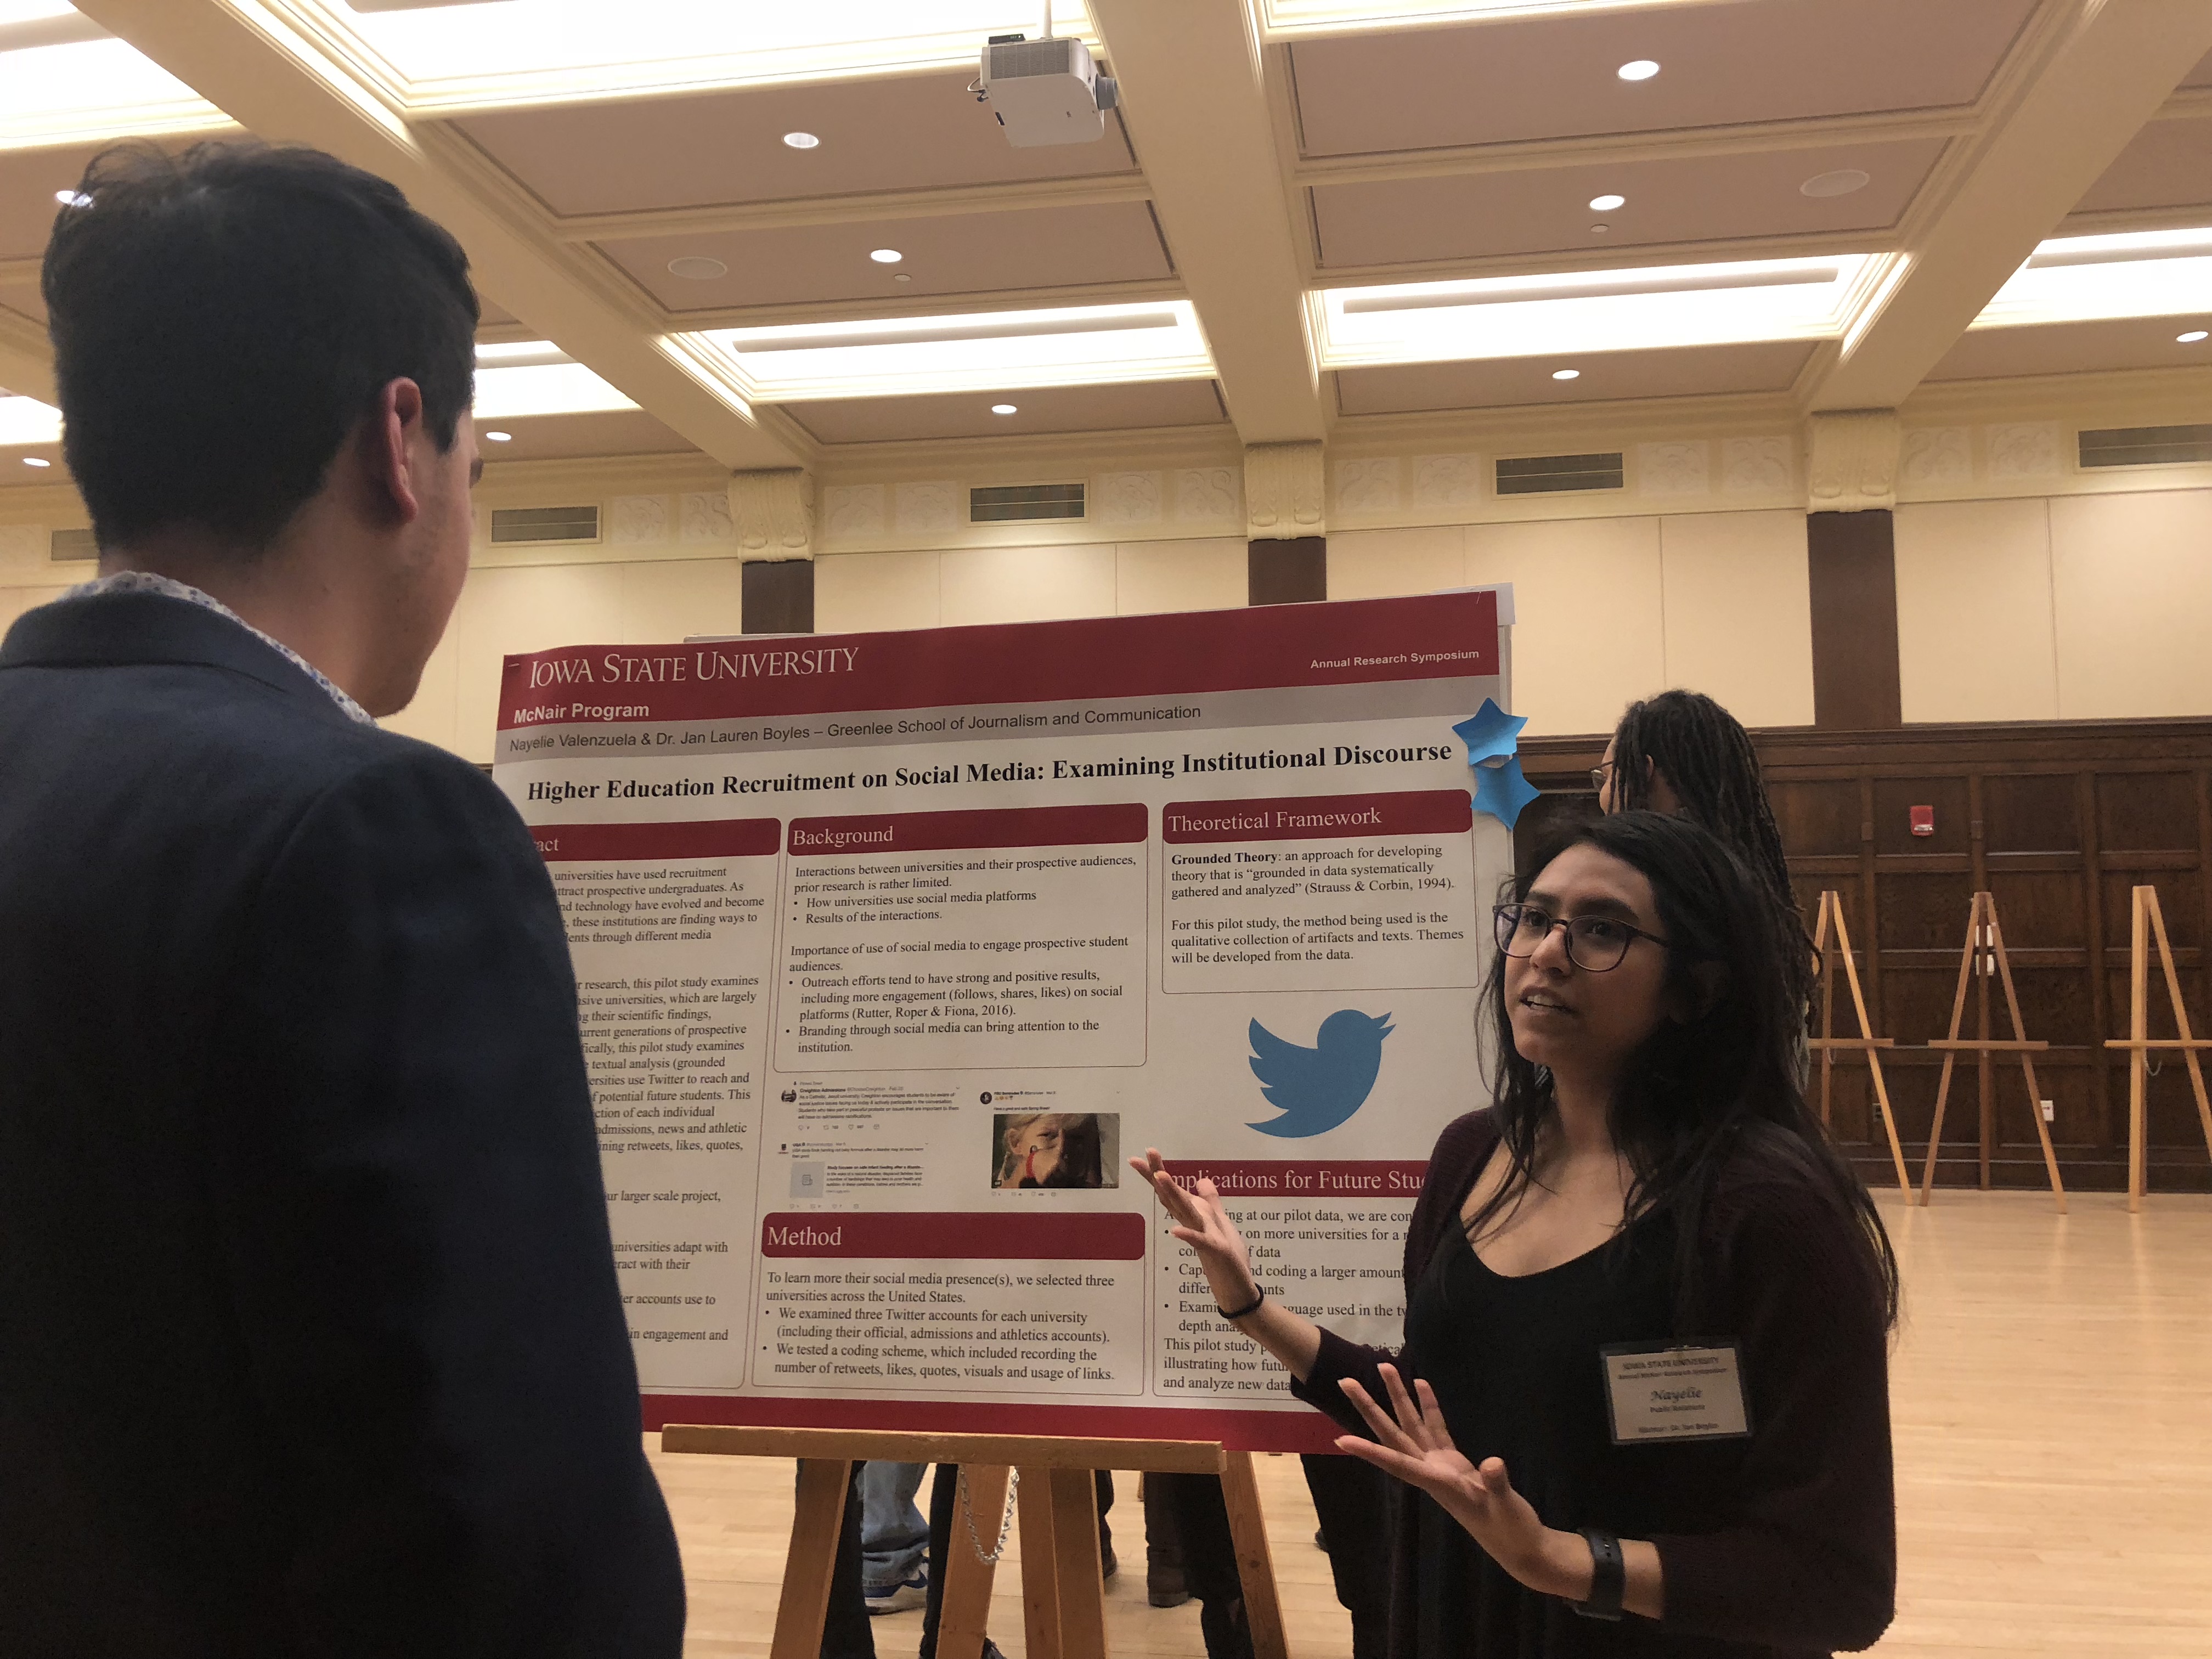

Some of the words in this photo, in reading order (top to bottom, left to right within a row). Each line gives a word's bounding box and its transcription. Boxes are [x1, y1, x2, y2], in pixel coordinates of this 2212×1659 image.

[529, 658, 595, 689] IOWA
[602, 653, 686, 683] STATE
[696, 647, 860, 680] UNIVERSITY
[1310, 657, 1350, 669] Annual
[1353, 653, 1407, 666] Research
[1410, 650, 1479, 664] Symposium
[514, 705, 567, 724] McNair
[572, 703, 650, 721] Program
[510, 736, 555, 753] Nayelie
[558, 733, 636, 747] Valenzuela
[641, 732, 651, 746] &
[656, 732, 675, 745] Dr.
[680, 731, 706, 744] Jan
[710, 730, 758, 743] Lauren
[763, 726, 810, 742] Boyles
[827, 721, 894, 737] Greenlee
[898, 718, 946, 733] School
[950, 716, 973, 730] of
[968, 714, 1047, 729] Journalism
[1052, 711, 1079, 725] and
[1085, 705, 1201, 724] Communication
[528, 781, 600, 804] Higher
[607, 778, 714, 798] Education
[722, 772, 856, 794] Recruitment
[862, 774, 888, 788] on
[895, 765, 959, 786] Social
[966, 761, 1043, 782] Media:
[1052, 756, 1175, 779] Examining
[1182, 747, 1326, 773] Institutional
[1333, 745, 1452, 766] Discourse
[1168, 811, 1269, 832] Theoretical
[1276, 806, 1382, 827] Framework
[793, 825, 893, 848] Background
[1171, 853, 1232, 865] Grounded
[1234, 852, 1281, 864] Theory:
[1285, 853, 1299, 861] an
[1301, 848, 1353, 863] approach
[1357, 847, 1374, 858] for
[1377, 844, 1443, 859] developing
[554, 870, 614, 881] universities
[616, 870, 641, 880] have
[644, 868, 667, 879] used
[669, 867, 727, 878] recruitment
[795, 865, 855, 877] Interactions
[859, 864, 901, 875] between
[904, 860, 964, 873] universities
[966, 859, 986, 870] and
[989, 859, 1014, 870] their
[1016, 856, 1077, 872] prospective
[1080, 855, 1136, 866] audiences,
[1171, 870, 1207, 883] theory
[1210, 869, 1231, 880] that
[1234, 868, 1243, 879] is
[1246, 866, 1306, 881] “grounded
[1309, 866, 1320, 877] in
[1323, 865, 1348, 876] data
[1351, 862, 1434, 878] systematically
[794, 882, 820, 895] prior
[822, 880, 865, 892] research
[868, 879, 877, 890] is
[879, 878, 910, 889] rather
[912, 876, 952, 888] limited.
[1171, 885, 1219, 900] gathered
[1222, 884, 1242, 896] and
[1245, 883, 1302, 898] analyzed”
[1305, 882, 1351, 895] (Strauss
[1354, 881, 1365, 891] &
[1369, 879, 1413, 891] Corbin,
[1418, 878, 1454, 890] 1994).
[575, 900, 632, 913] technology
[635, 900, 659, 911] have
[661, 898, 702, 910] evolved
[703, 897, 723, 908] and
[725, 897, 765, 907] become
[1171, 935, 1230, 950] qualitative
[1233, 933, 1289, 945] collection
[1292, 932, 1306, 944] of
[1307, 932, 1354, 944] artifacts
[1357, 930, 1379, 942] and
[1381, 932, 1413, 941] texts.
[1416, 929, 1464, 940] Themes
[605, 994, 667, 1006] universities,
[669, 992, 700, 1003] which
[702, 995, 719, 1003] are
[721, 991, 757, 1005] largely
[801, 992, 850, 1006] including
[853, 994, 879, 1002] more
[882, 991, 946, 1004] engagement
[949, 989, 997, 1002] (follows,
[1000, 988, 1037, 1000] shares,
[1041, 986, 1071, 1000] likes)
[1074, 989, 1087, 997] on
[1091, 985, 1122, 996] social
[799, 1025, 847, 1038] Branding
[850, 1023, 890, 1037] through
[894, 1023, 925, 1034] social
[928, 1022, 961, 1033] media
[963, 1024, 983, 1033] can
[986, 1020, 1015, 1035] bring
[1017, 1020, 1065, 1032] attention
[1068, 1021, 1079, 1030] to
[1082, 1019, 1099, 1030] the
[599, 1091, 644, 1104] potential
[646, 1090, 678, 1101] future
[679, 1089, 724, 1101] students.
[727, 1088, 751, 1100] This
[1171, 1169, 1278, 1192] mpcations
[1284, 1170, 1312, 1189] for
[1318, 1170, 1381, 1189] Future
[768, 1226, 841, 1246] Method
[1245, 1230, 1261, 1239] on
[1264, 1231, 1295, 1239] more
[1298, 1227, 1368, 1240] universities
[1371, 1228, 1389, 1240] for
[1392, 1232, 1400, 1240] a
[767, 1272, 782, 1283] To
[785, 1272, 811, 1283] learn
[814, 1275, 842, 1284] more
[845, 1272, 871, 1284] their
[873, 1272, 905, 1284] social
[909, 1272, 943, 1284] media
[945, 1273, 1013, 1288] presence(s),
[1016, 1277, 1033, 1285] we
[1036, 1274, 1082, 1286] selected
[1085, 1274, 1115, 1286] three
[777, 1325, 832, 1340] (including
[836, 1325, 862, 1338] their
[864, 1326, 907, 1339] official,
[910, 1327, 973, 1340] admissions
[976, 1328, 997, 1340] and
[1000, 1328, 1048, 1341] athletics
[1051, 1330, 1110, 1345] accounts).
[1164, 1338, 1190, 1350] This
[1193, 1338, 1221, 1353] pilot
[1224, 1339, 1257, 1355] study
[1164, 1357, 1228, 1373] illustrating
[1231, 1358, 1257, 1370] how
[1163, 1375, 1185, 1389] and
[1188, 1376, 1234, 1392] analyze
[1237, 1381, 1262, 1390] new
